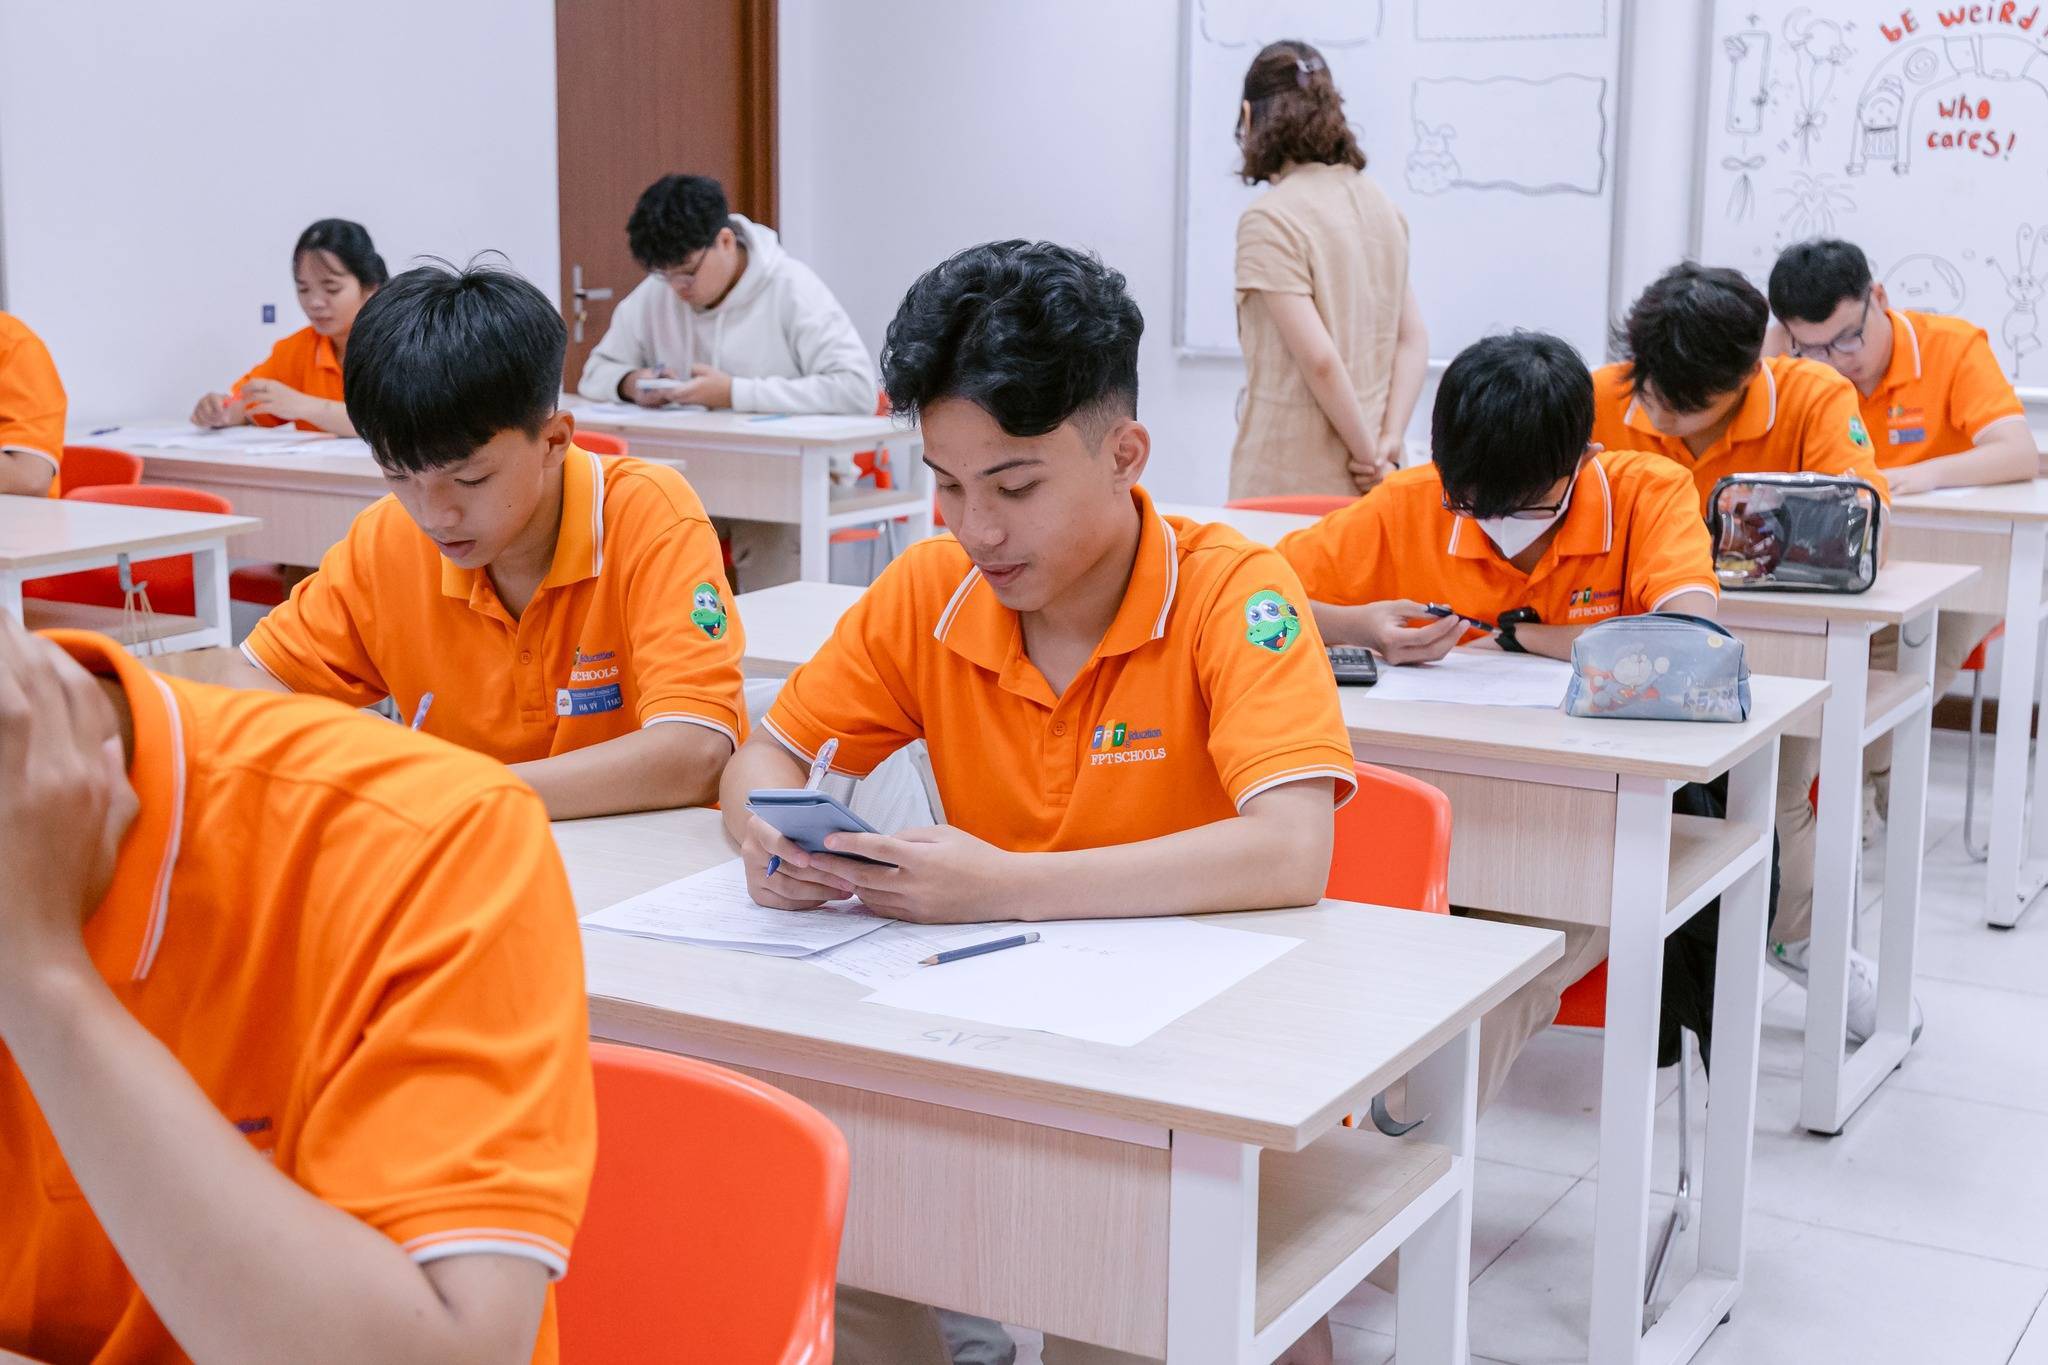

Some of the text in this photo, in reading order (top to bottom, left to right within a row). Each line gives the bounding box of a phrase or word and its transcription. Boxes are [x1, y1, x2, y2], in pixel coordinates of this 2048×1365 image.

[1927, 129, 2016, 162] cares!
[1092, 726, 1126, 746] FPT
[1091, 748, 1166, 765] FPT SCHOOLS
